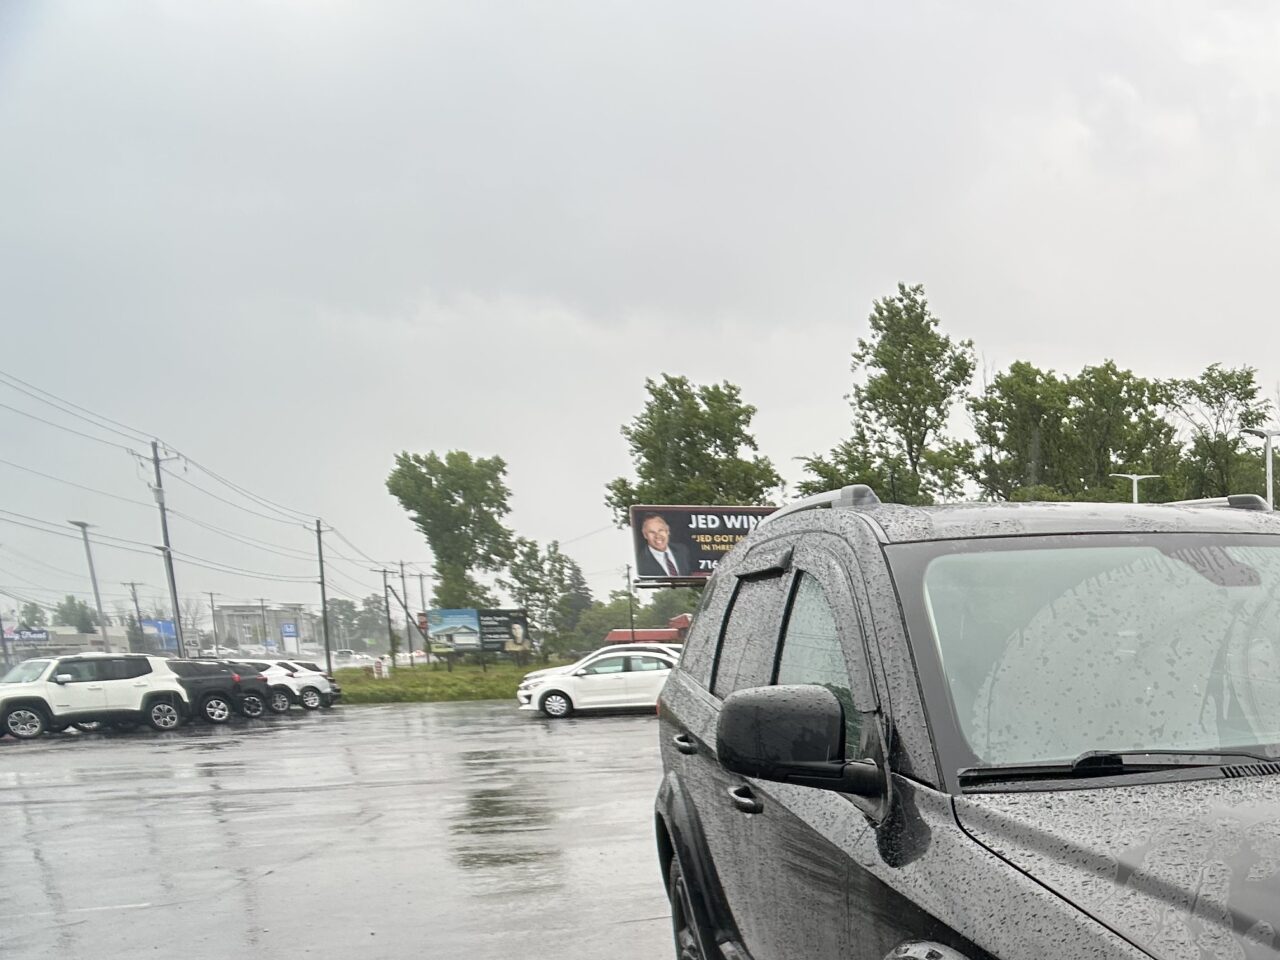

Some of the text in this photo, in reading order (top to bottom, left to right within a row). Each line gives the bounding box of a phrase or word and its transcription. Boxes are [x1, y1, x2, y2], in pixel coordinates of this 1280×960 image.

[688, 514, 720, 529] JED
[713, 534, 734, 543] GOT
[185, 640, 199, 648] 45
